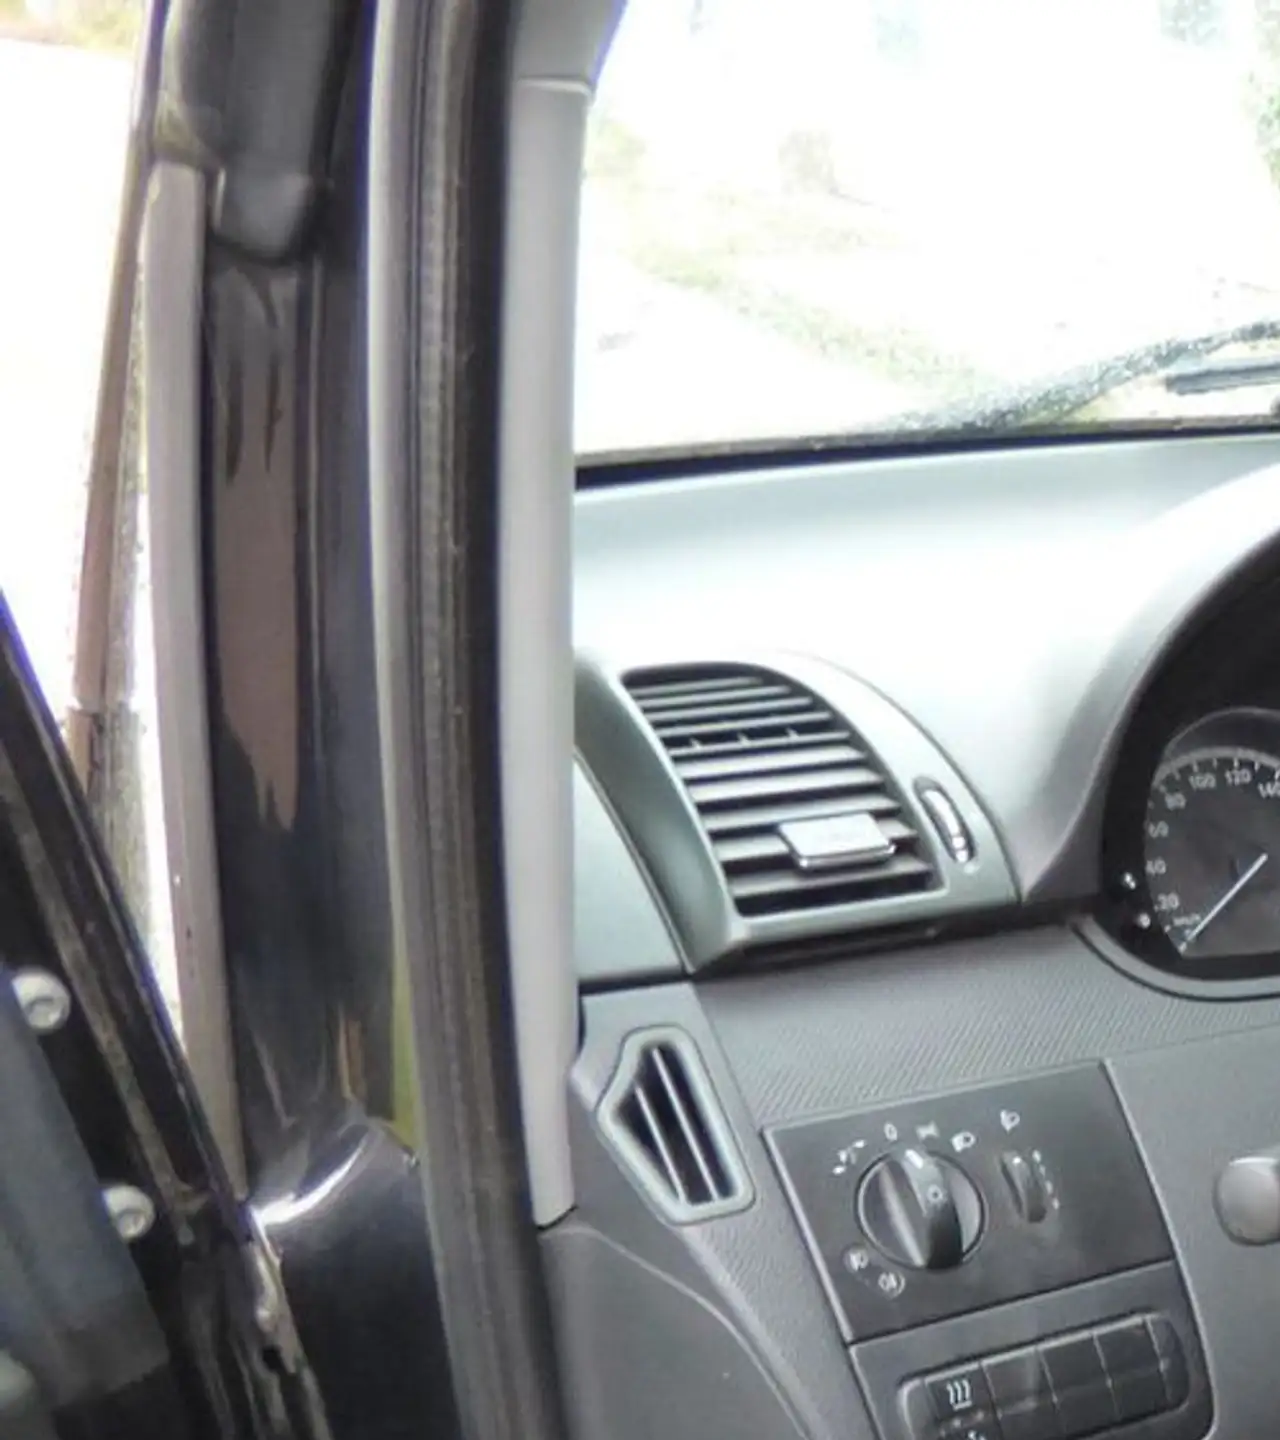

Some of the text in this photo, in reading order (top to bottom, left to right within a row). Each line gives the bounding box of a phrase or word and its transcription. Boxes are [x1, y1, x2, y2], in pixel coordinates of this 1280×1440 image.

[1188, 773, 1216, 791] 100
[1225, 768, 1252, 786] 120
[1164, 793, 1187, 811] 80
[1149, 821, 1169, 838] 60
[1146, 857, 1167, 875] 40
[1157, 893, 1180, 911] 20
